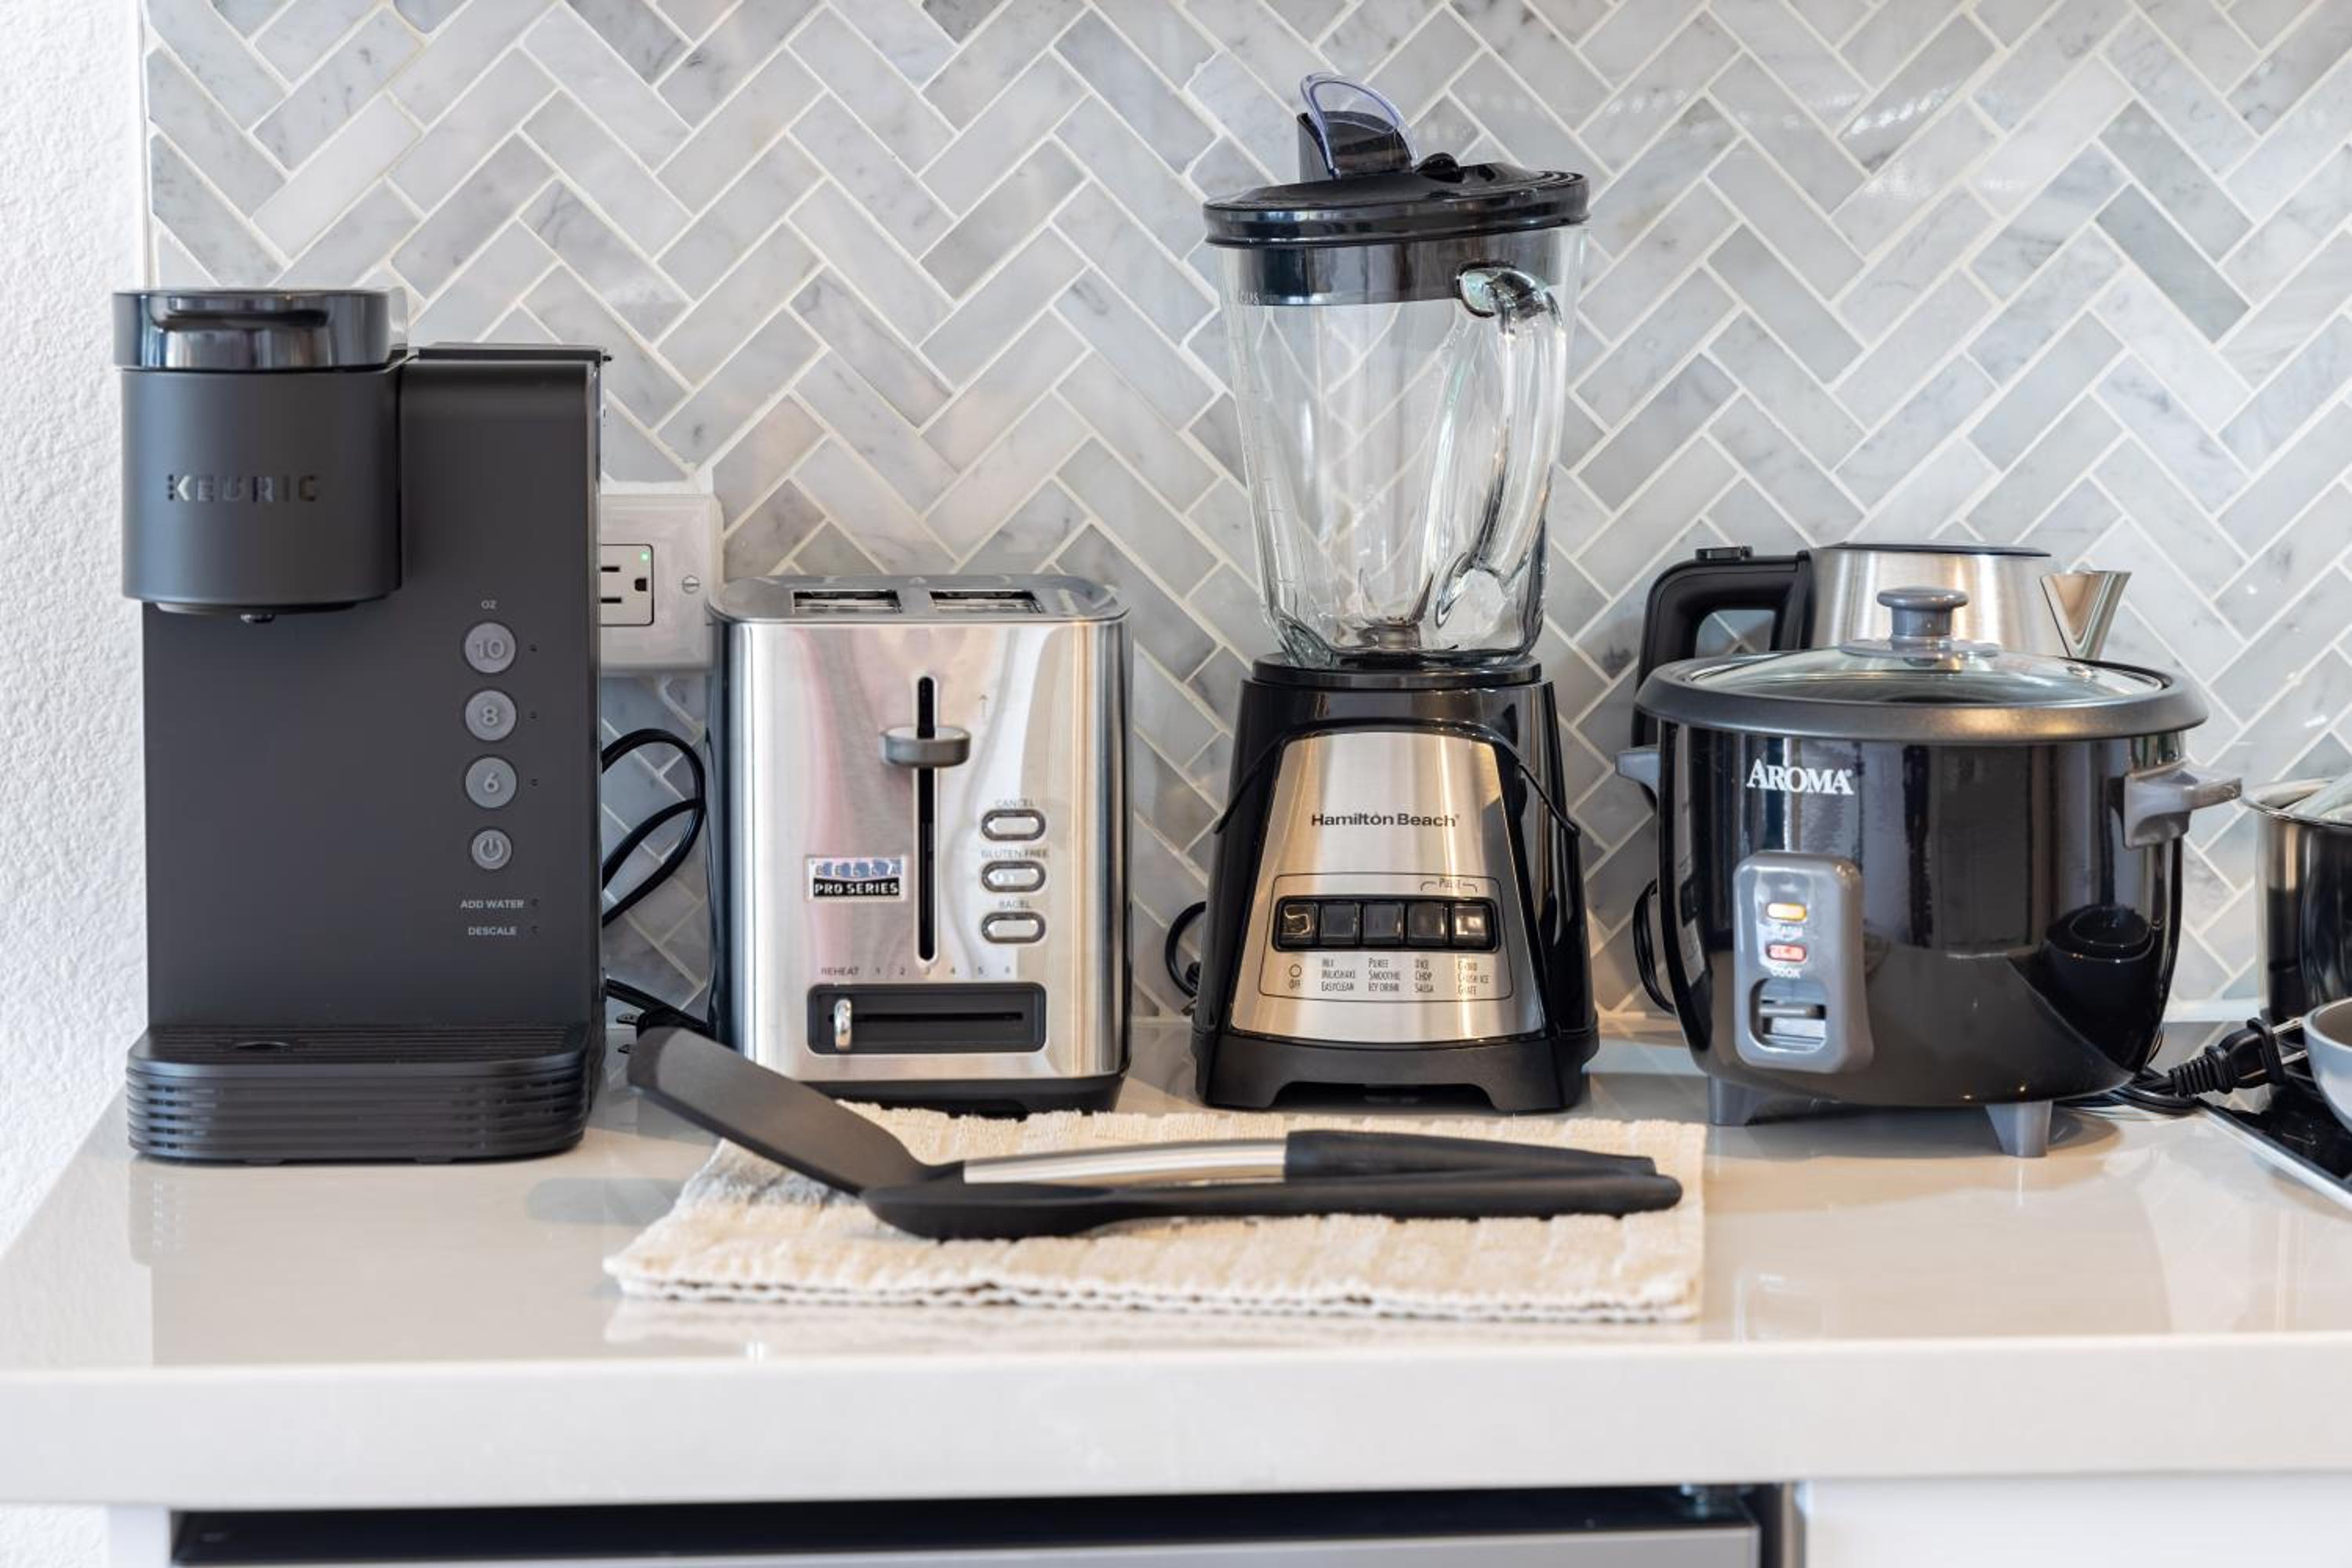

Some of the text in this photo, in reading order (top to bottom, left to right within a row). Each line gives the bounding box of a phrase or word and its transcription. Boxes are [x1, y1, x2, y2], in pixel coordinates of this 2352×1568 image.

[477, 640, 505, 659] 10
[483, 706, 498, 726] 8
[484, 772, 499, 793] 6
[1311, 813, 1393, 826] Hamilton
[1024, 849, 1049, 858] FREE
[814, 882, 898, 895] PRO SERIES
[460, 899, 524, 909] ADD WATER
[468, 927, 517, 935] DESCALE
[821, 967, 860, 976] REHEAT
